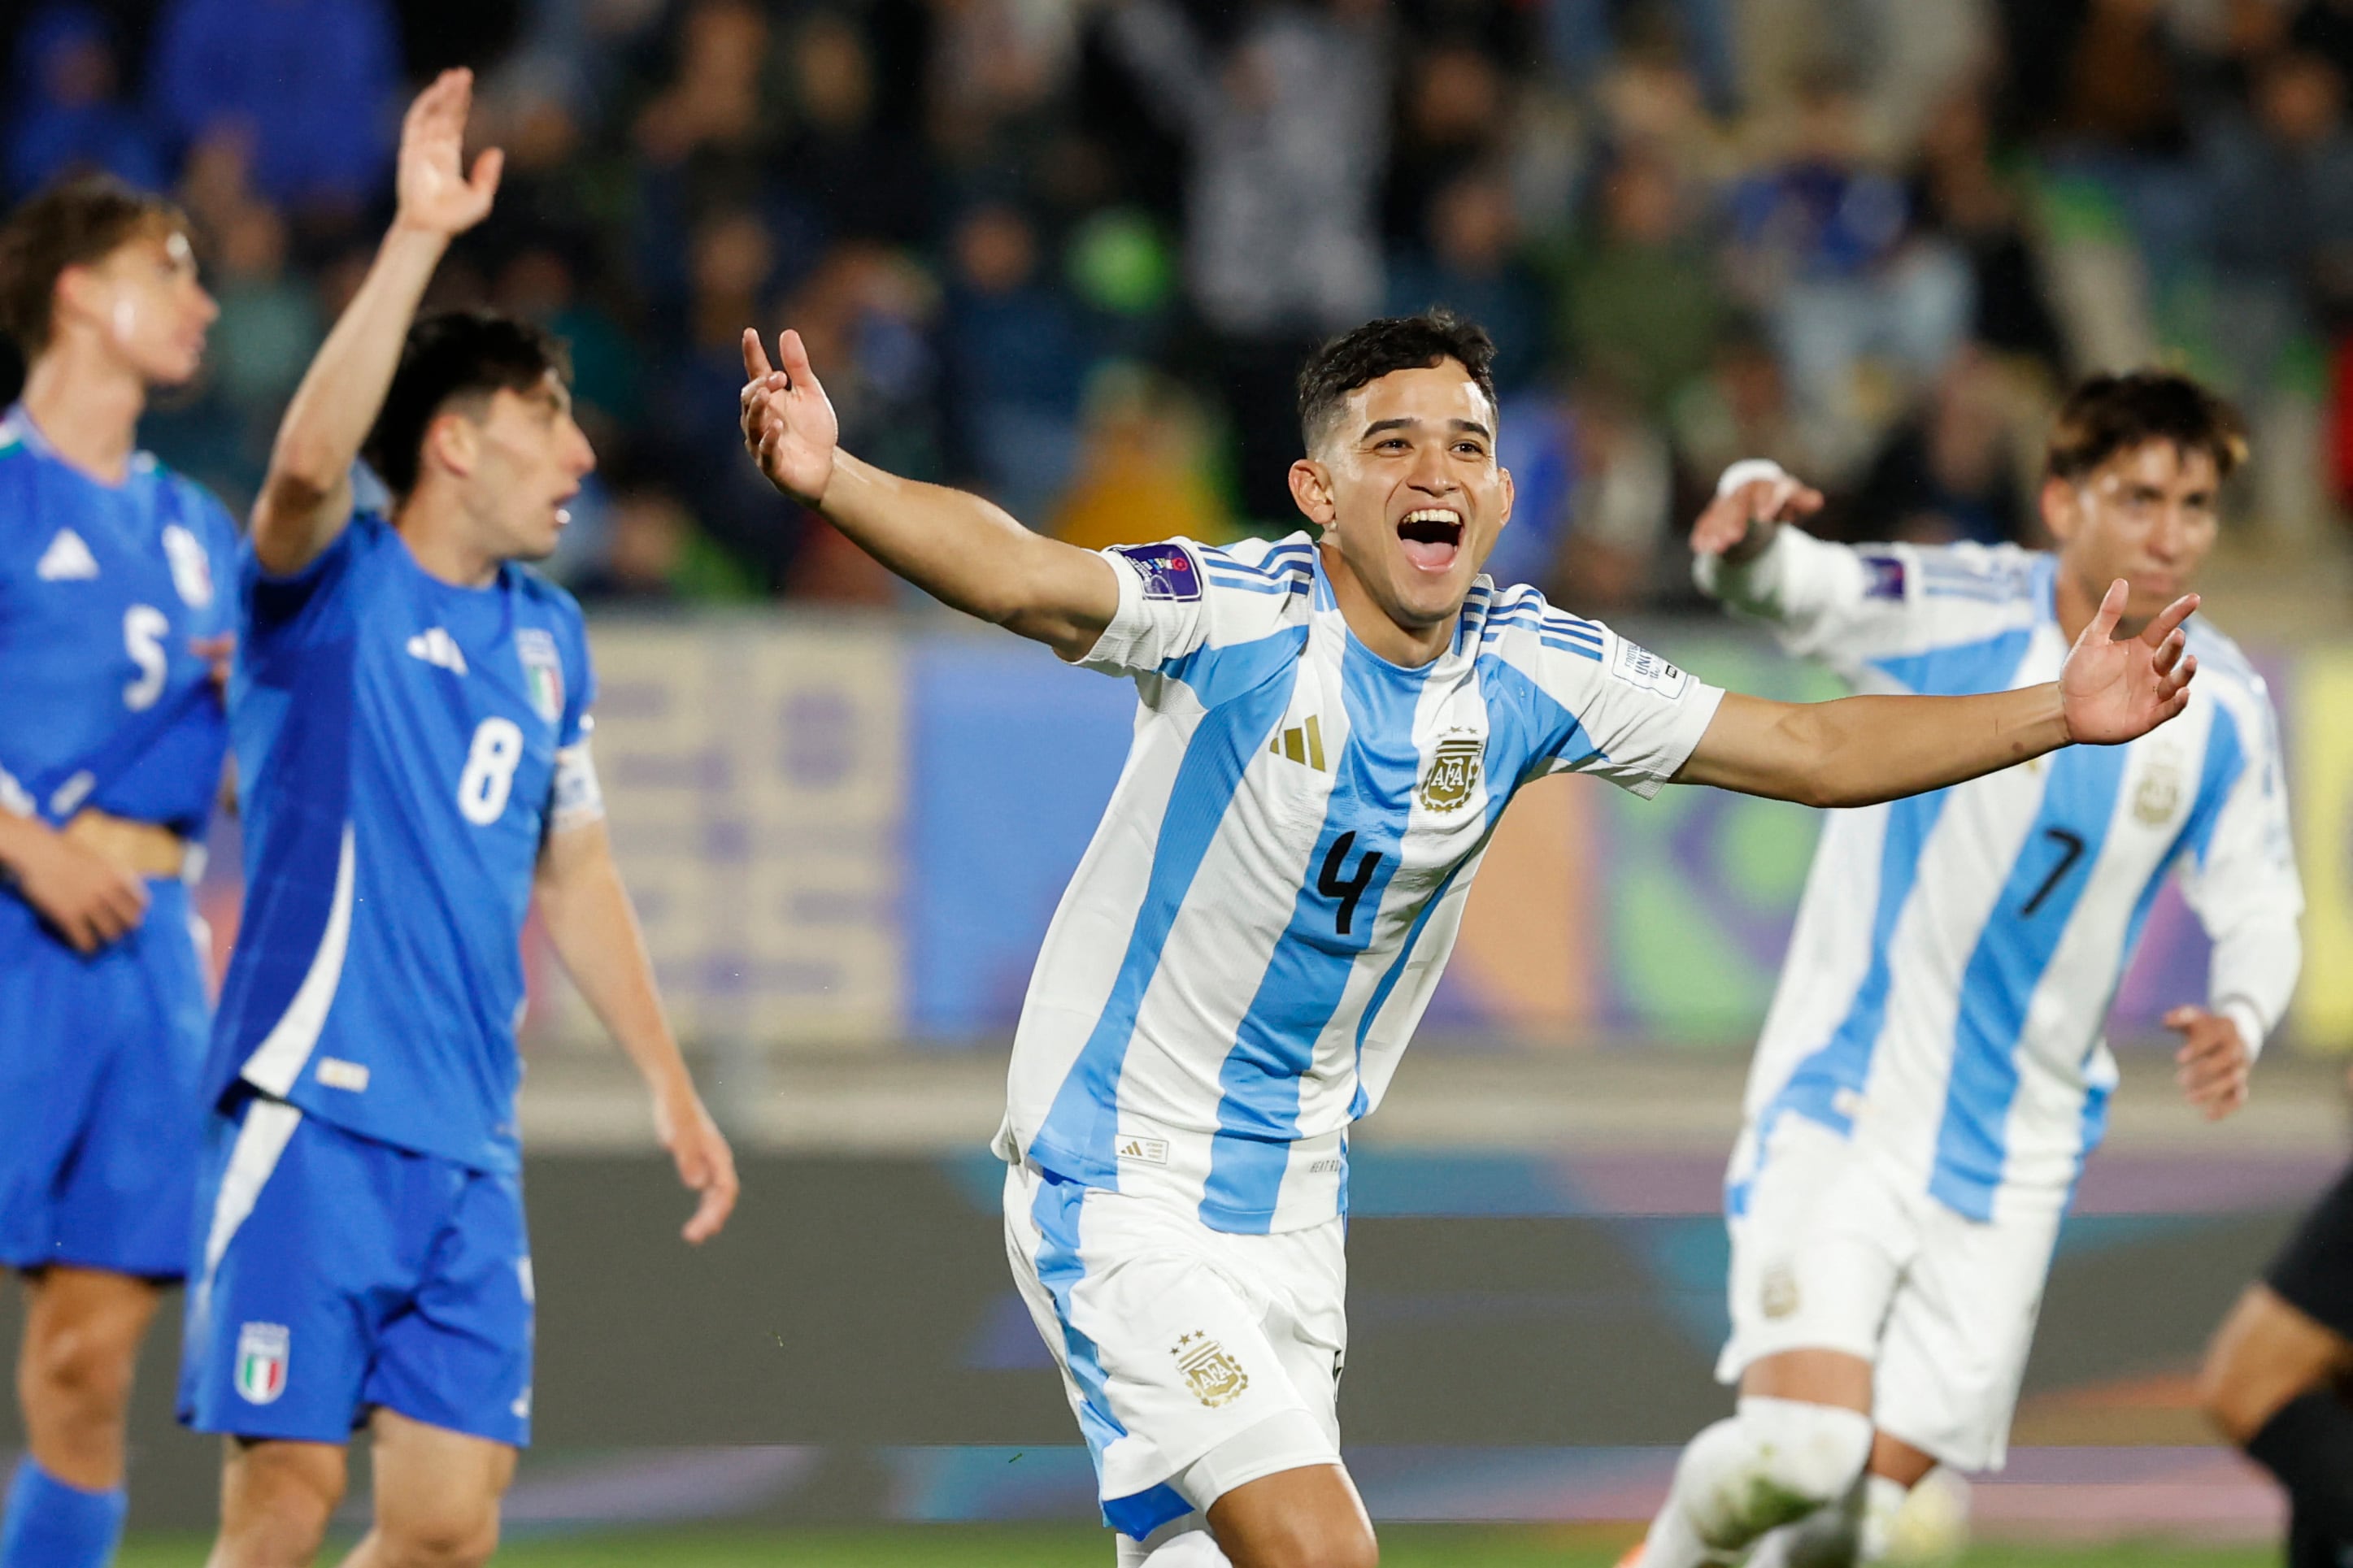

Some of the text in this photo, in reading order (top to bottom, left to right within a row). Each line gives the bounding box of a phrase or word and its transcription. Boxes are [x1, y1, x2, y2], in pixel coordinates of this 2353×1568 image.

[124, 604, 169, 712] 5
[458, 716, 524, 826] 8
[1429, 757, 1465, 793] AFA
[1317, 830, 1383, 935] 4
[2020, 827, 2085, 917] 7
[1308, 1158, 1340, 1173] HEAT.RD
